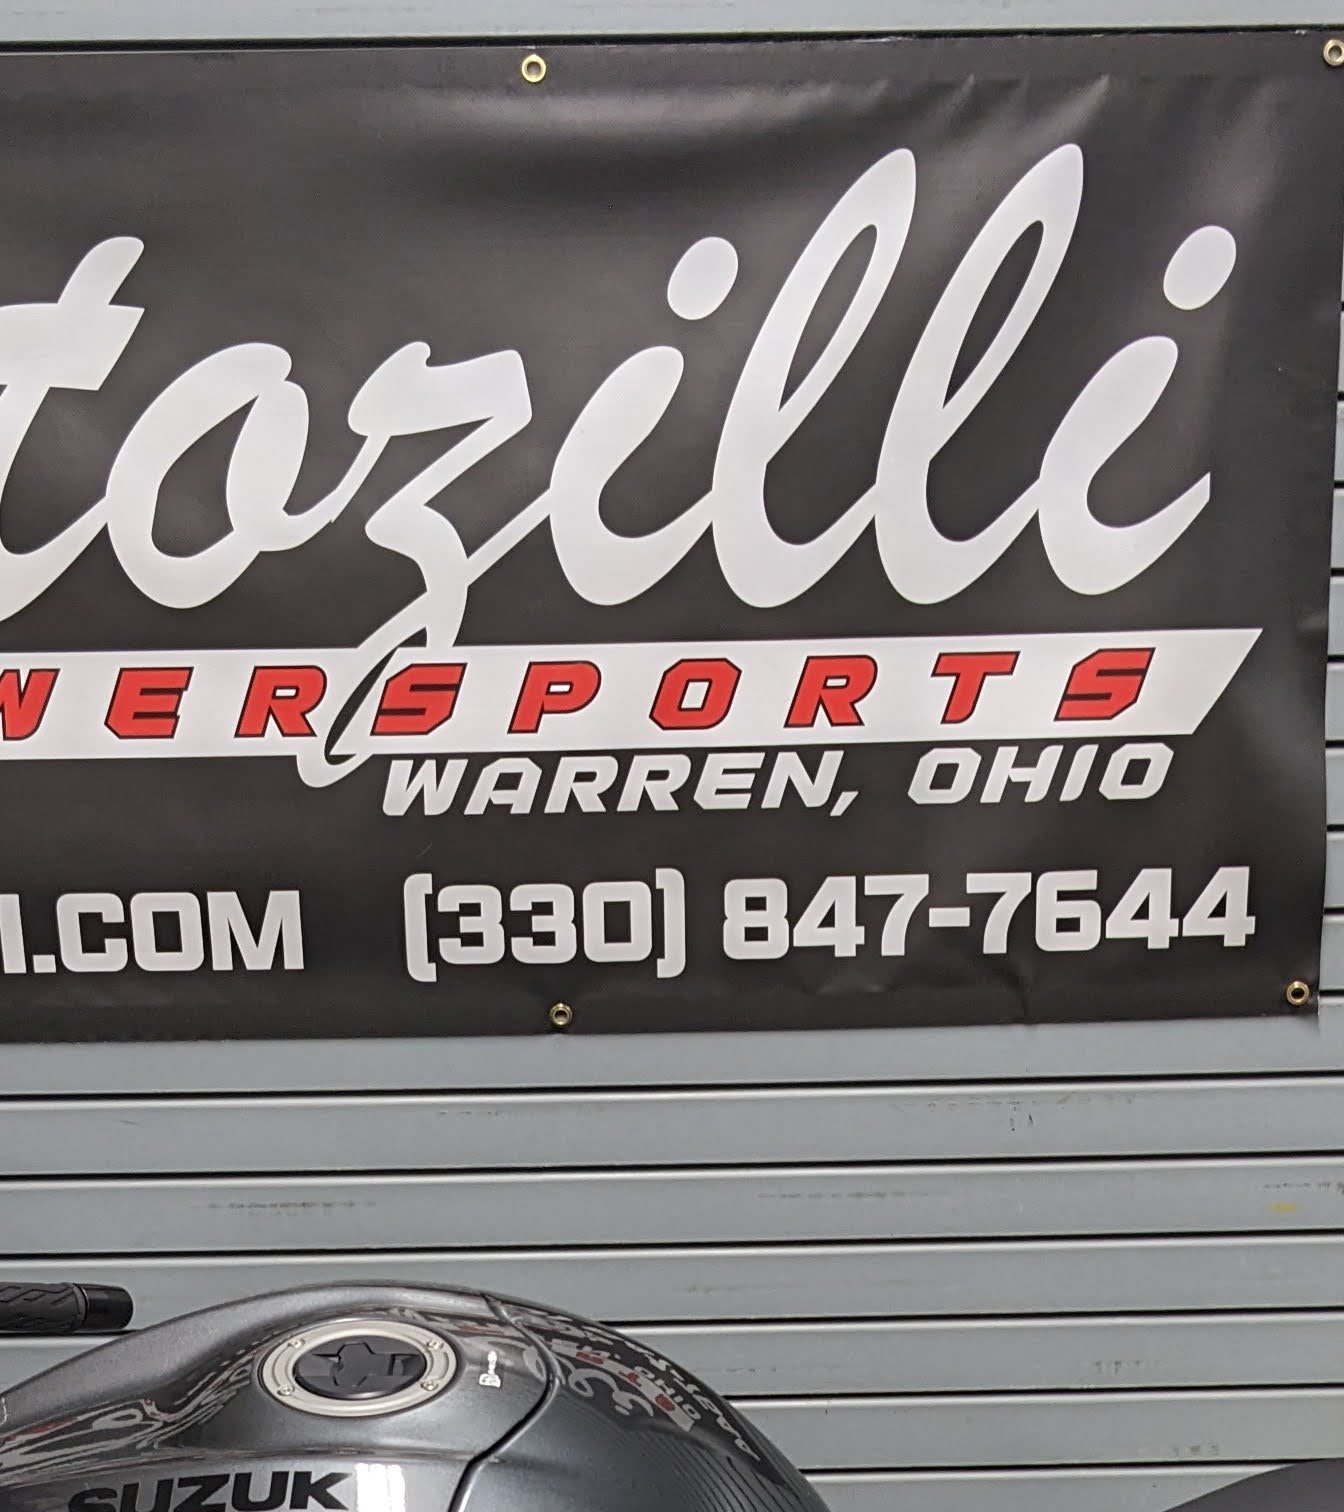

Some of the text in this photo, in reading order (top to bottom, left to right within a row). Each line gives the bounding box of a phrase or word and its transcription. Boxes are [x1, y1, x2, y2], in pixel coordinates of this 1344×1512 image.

[381, 742, 1174, 817] WARREN, OHIO
[402, 866, 686, 983] (330)
[722, 865, 1256, 960] 847-7644
